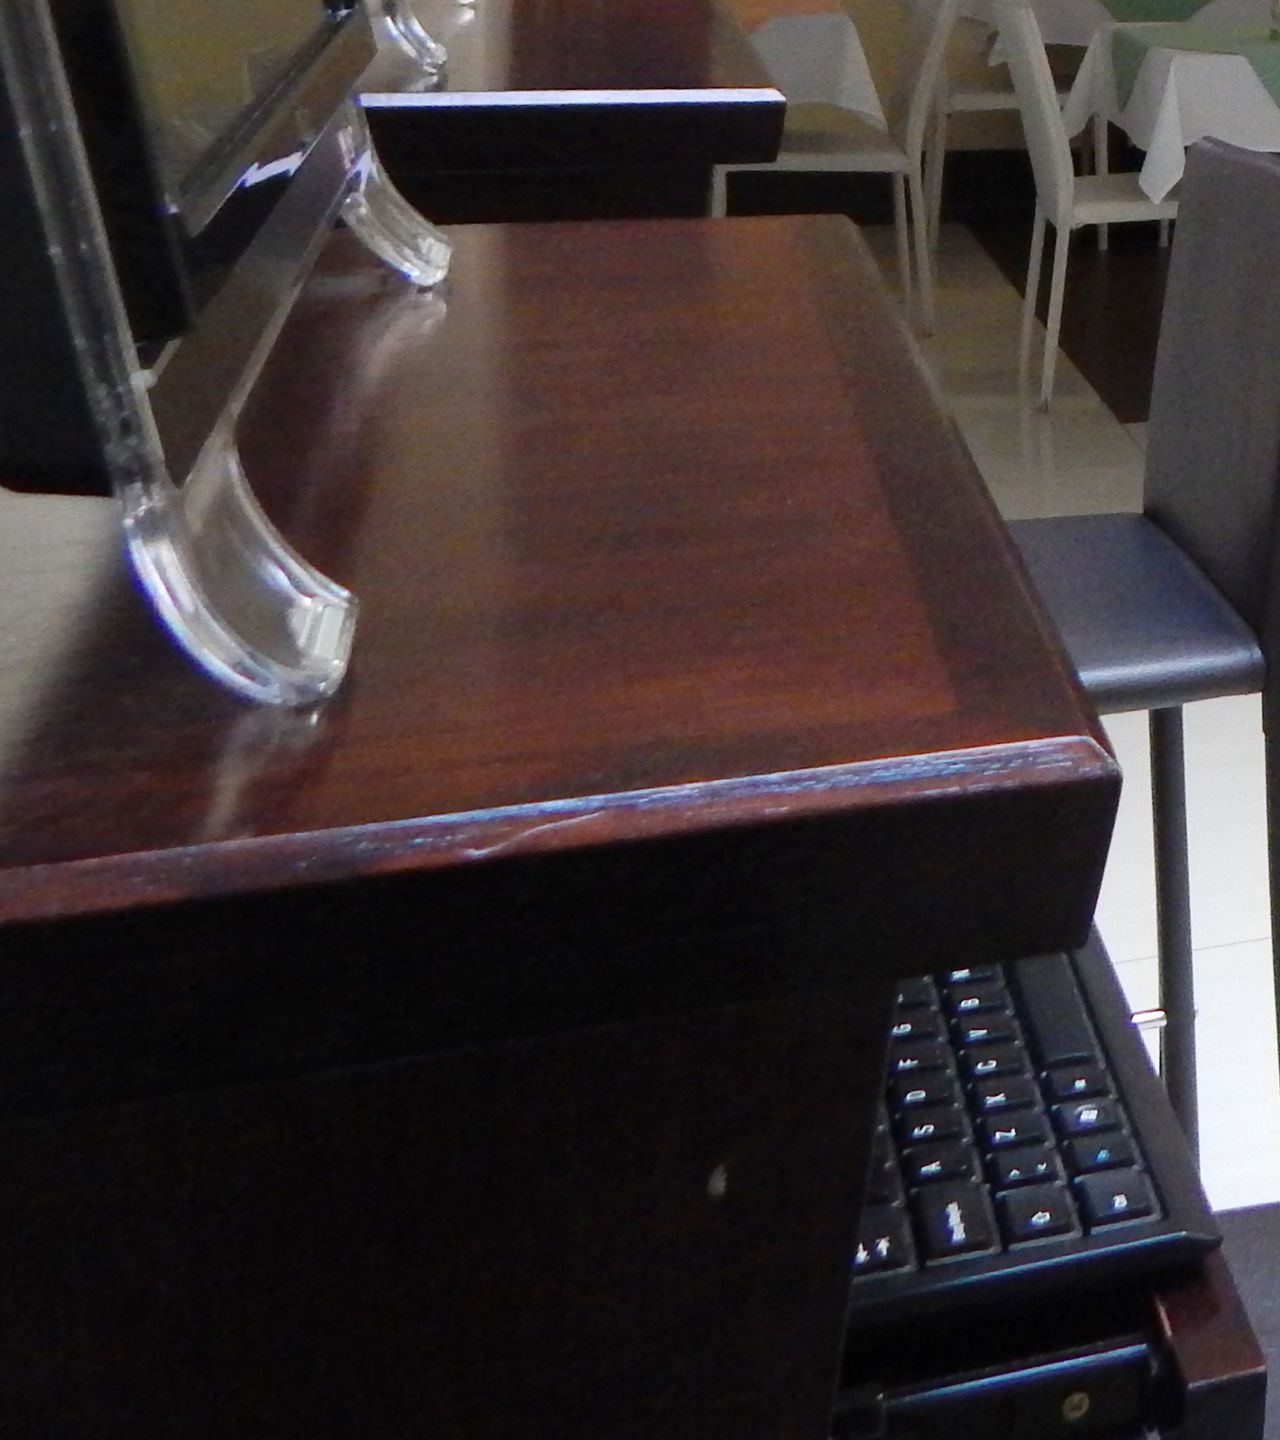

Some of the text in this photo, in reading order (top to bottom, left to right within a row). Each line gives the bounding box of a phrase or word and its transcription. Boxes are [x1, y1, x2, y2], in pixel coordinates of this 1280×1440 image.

[960, 997, 979, 1008] B
[892, 1024, 911, 1036] G
[968, 1030, 988, 1040] V
[899, 1059, 918, 1069] F
[977, 1060, 997, 1072] C
[906, 1090, 926, 1101] D
[985, 1093, 1006, 1105] X
[913, 1124, 934, 1136] S
[995, 1128, 1016, 1140] Z
[920, 1161, 941, 1173] A
